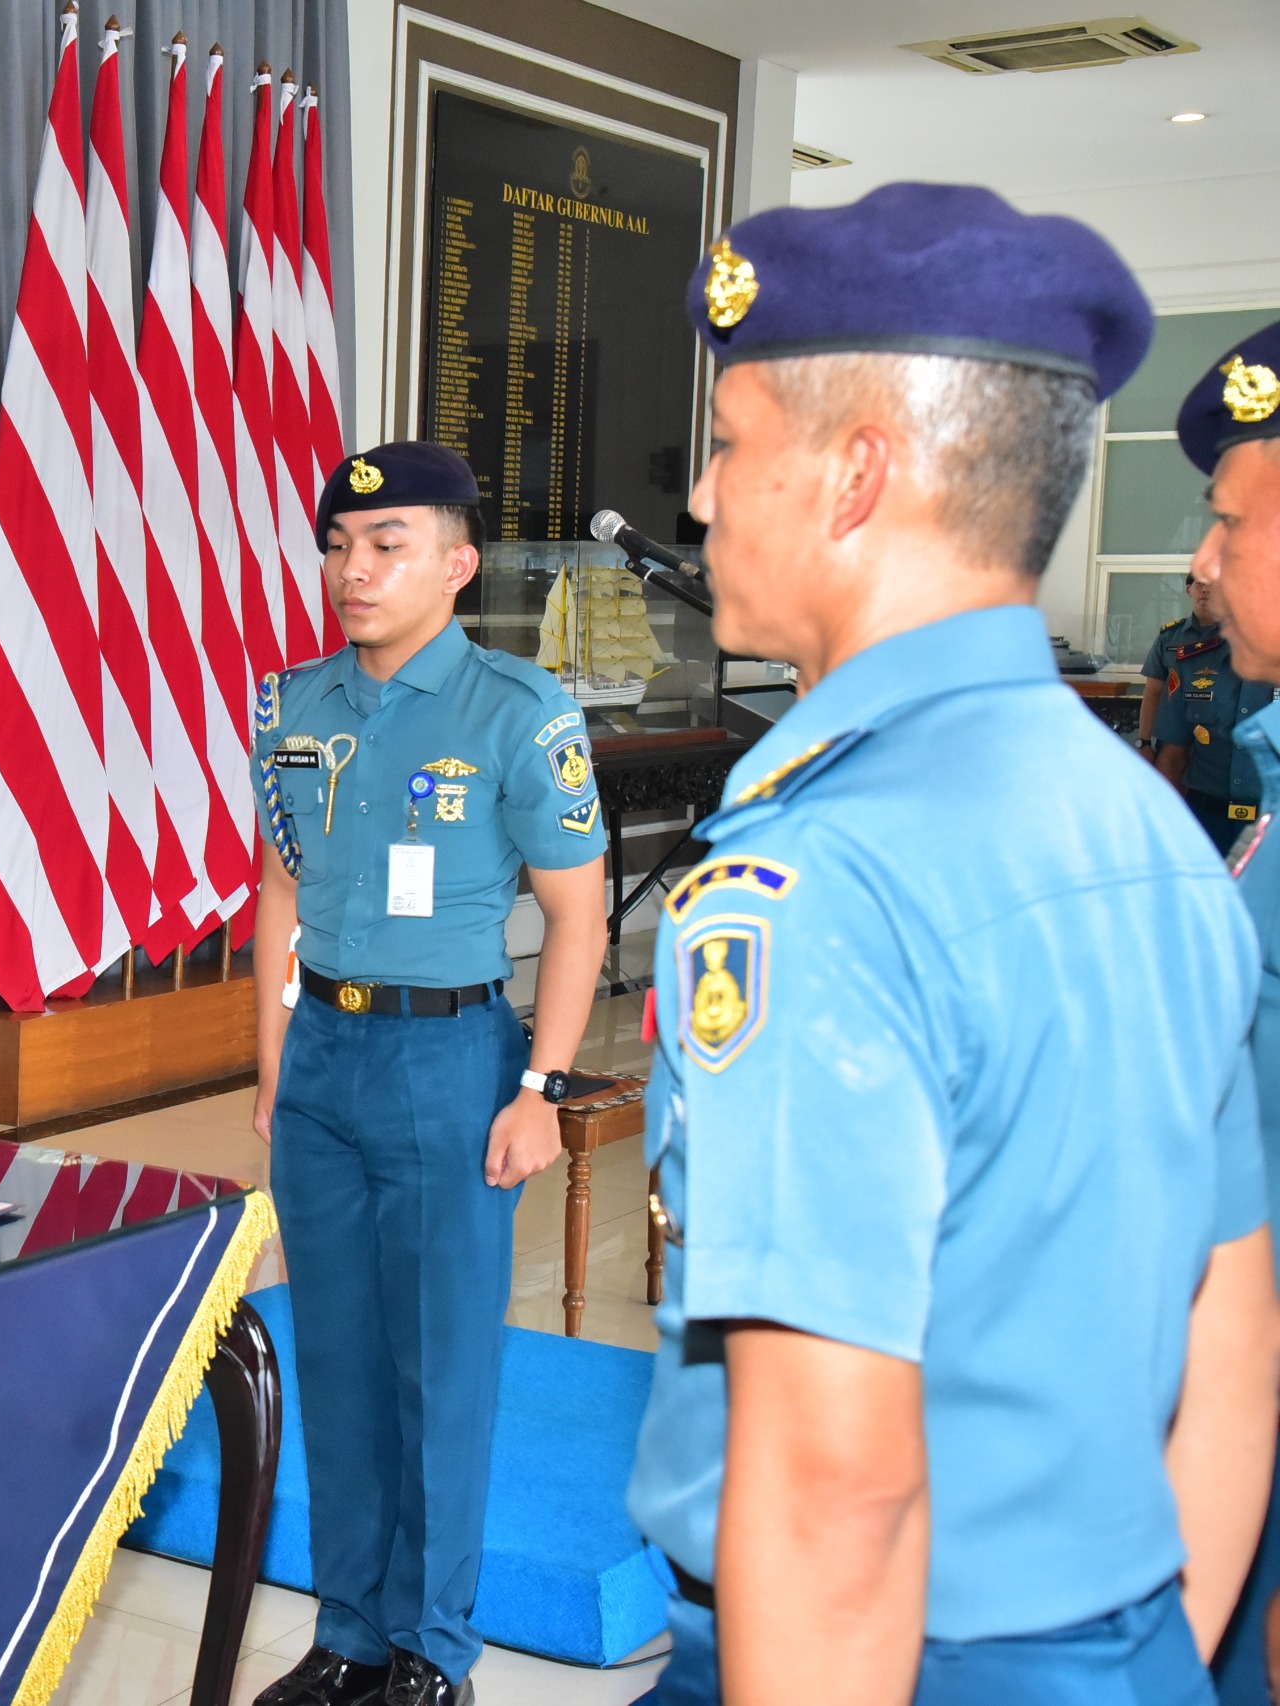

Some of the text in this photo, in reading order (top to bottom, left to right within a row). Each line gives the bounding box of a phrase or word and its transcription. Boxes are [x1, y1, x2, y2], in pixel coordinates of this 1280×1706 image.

[502, 183, 650, 235] DAFTAR GUBERNUR AAL
[276, 755, 288, 763] ALIF
[572, 804, 591, 819] TNI
